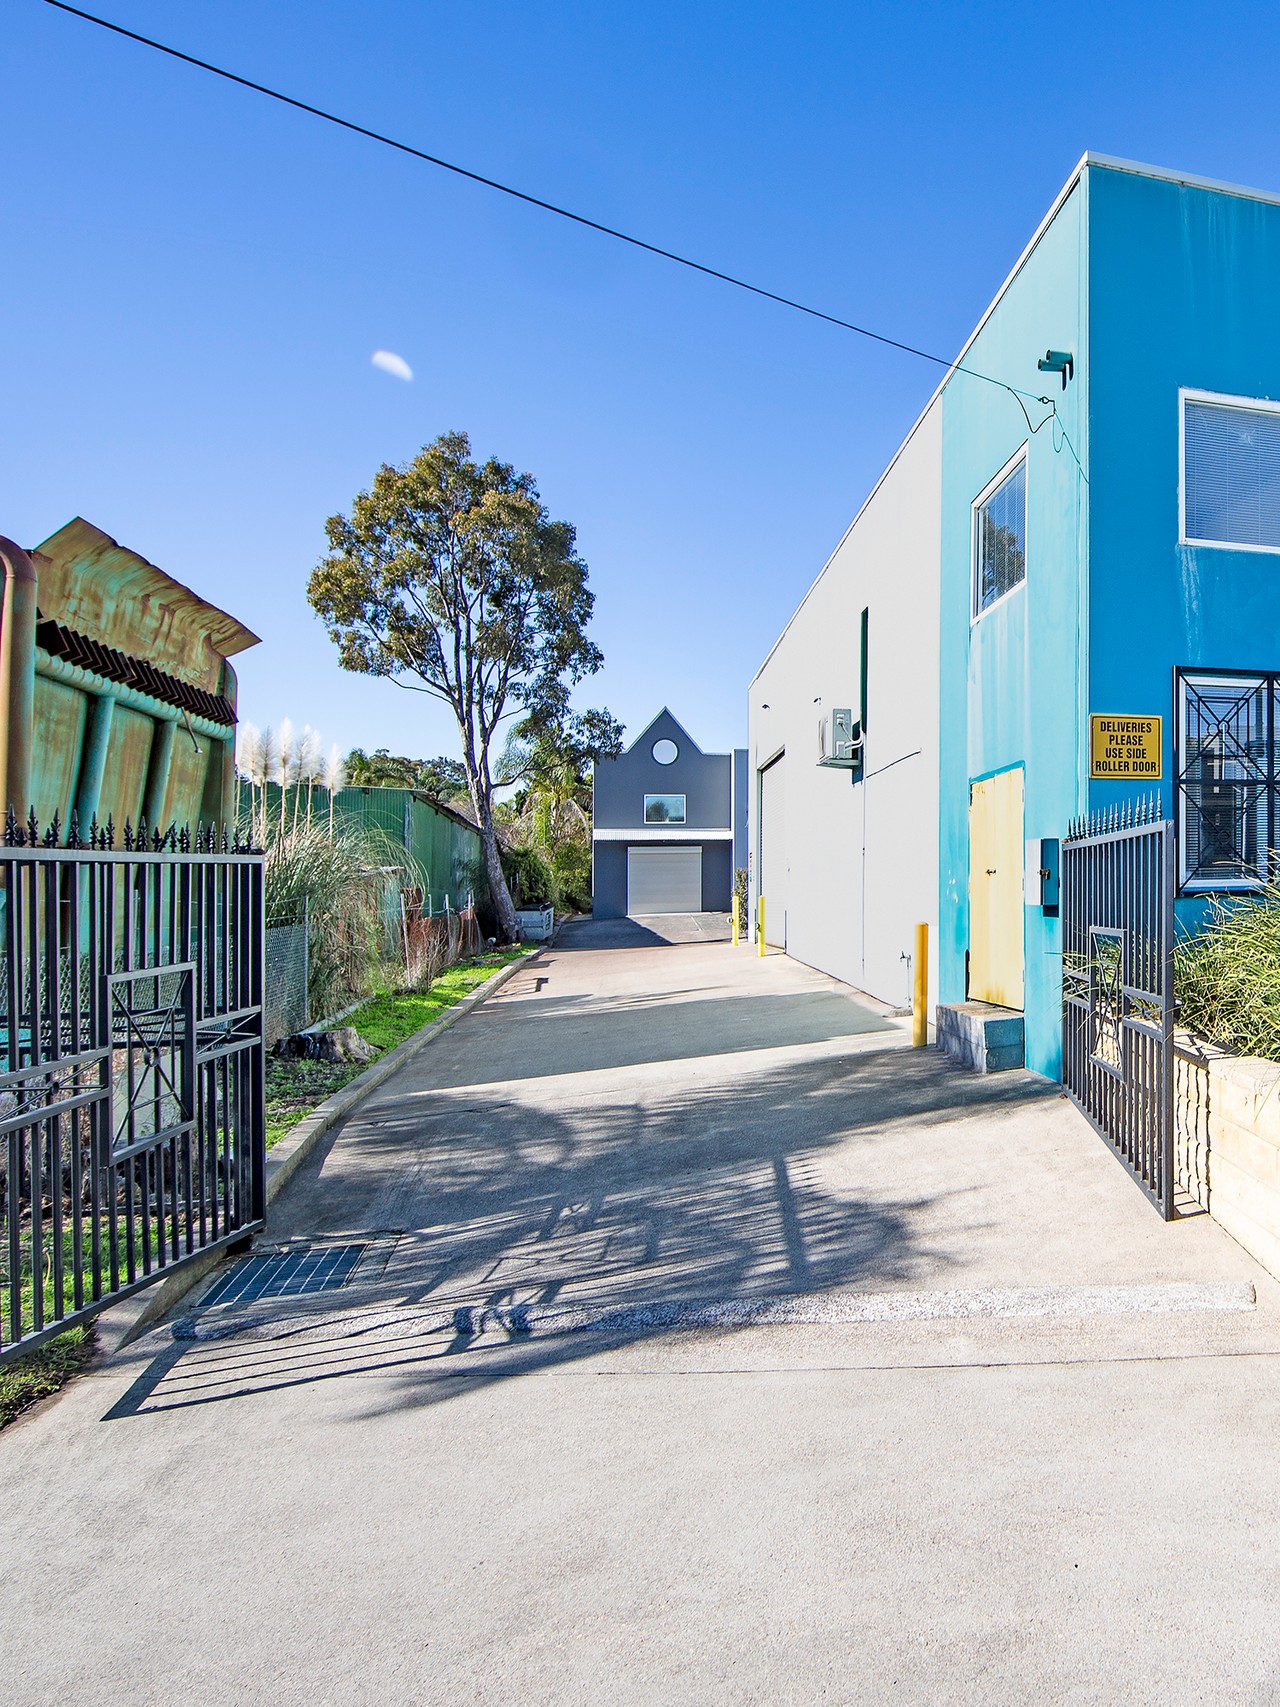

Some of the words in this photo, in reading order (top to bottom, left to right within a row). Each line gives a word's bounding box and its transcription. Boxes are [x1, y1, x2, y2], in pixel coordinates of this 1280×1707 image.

[1100, 721, 1152, 733] DELIVERIES
[1109, 735, 1144, 746] PLEASE
[1105, 748, 1124, 759] USE
[1126, 748, 1147, 759] SIDE
[1095, 761, 1130, 772] ROLLER
[1132, 761, 1157, 772] DOOR
